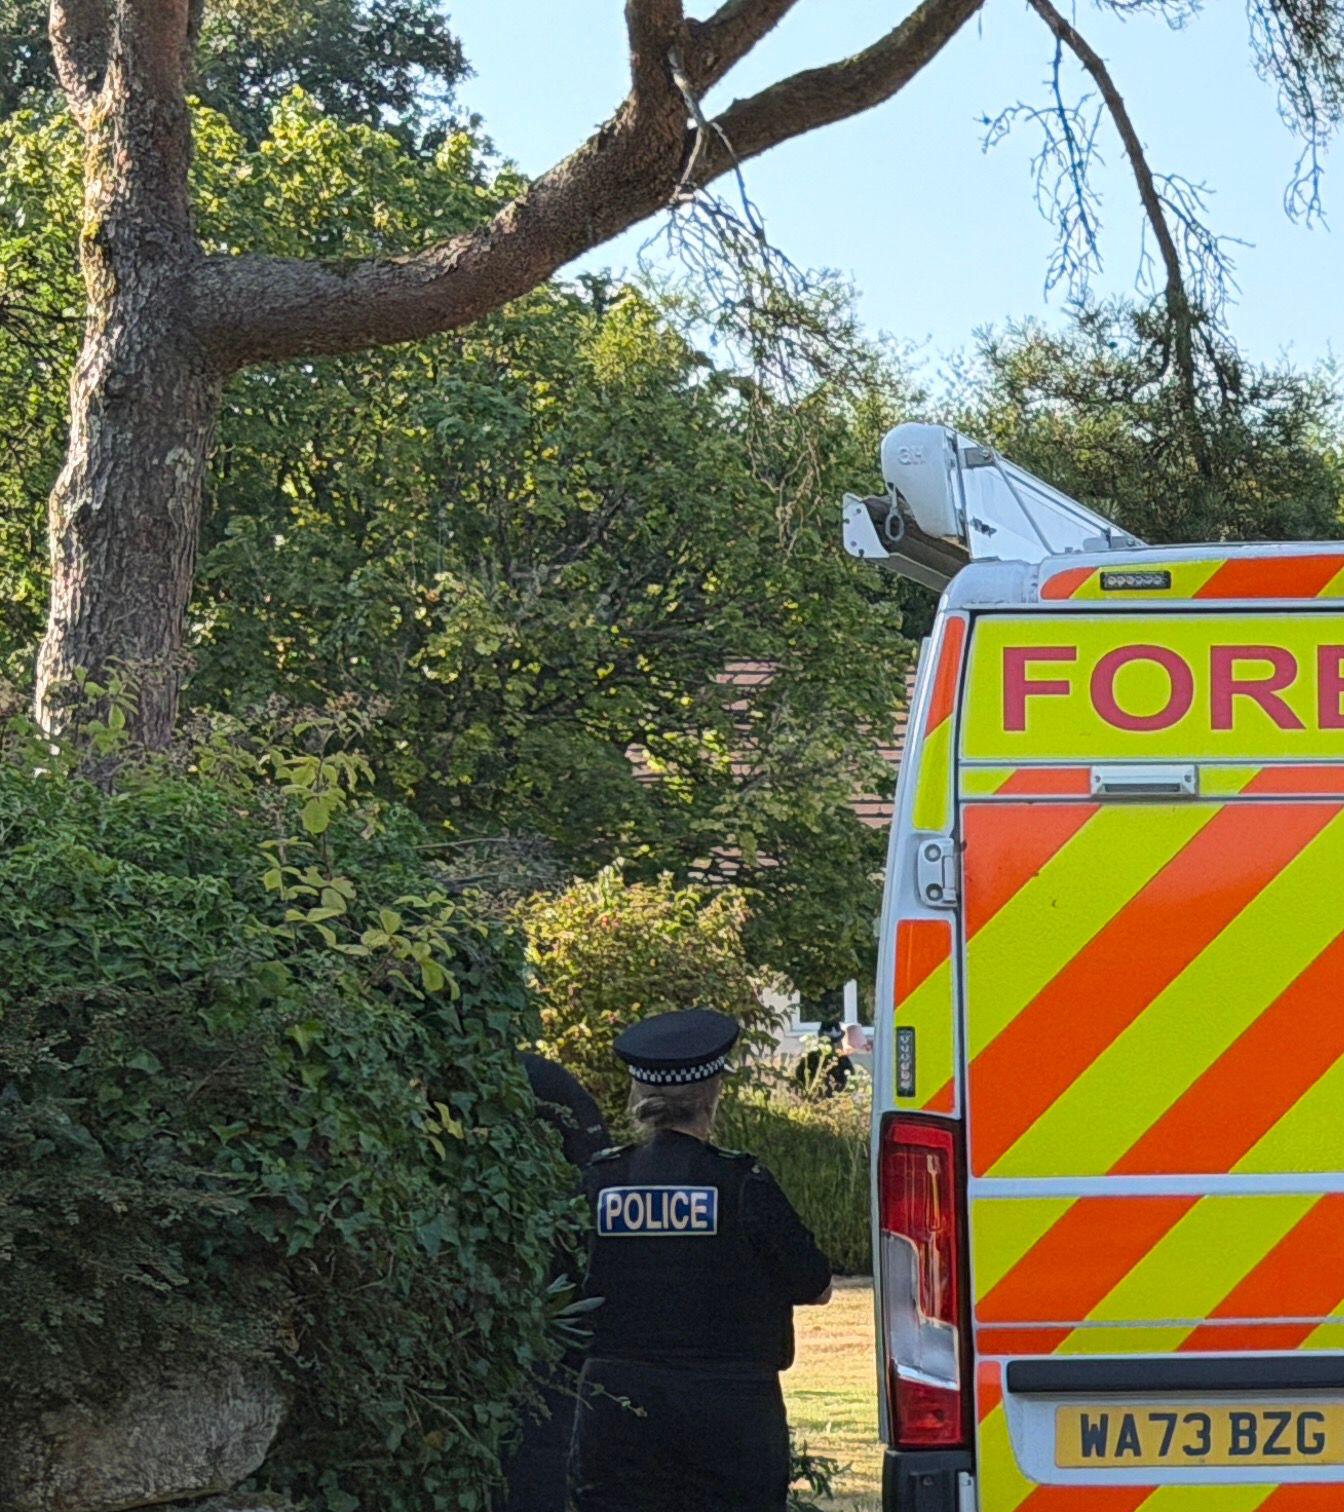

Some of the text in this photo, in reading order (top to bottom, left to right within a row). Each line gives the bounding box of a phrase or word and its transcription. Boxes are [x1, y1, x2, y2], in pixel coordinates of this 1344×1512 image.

[605, 1191, 709, 1231] POLICE
[1080, 1410, 1326, 1458] WA73 BZG
